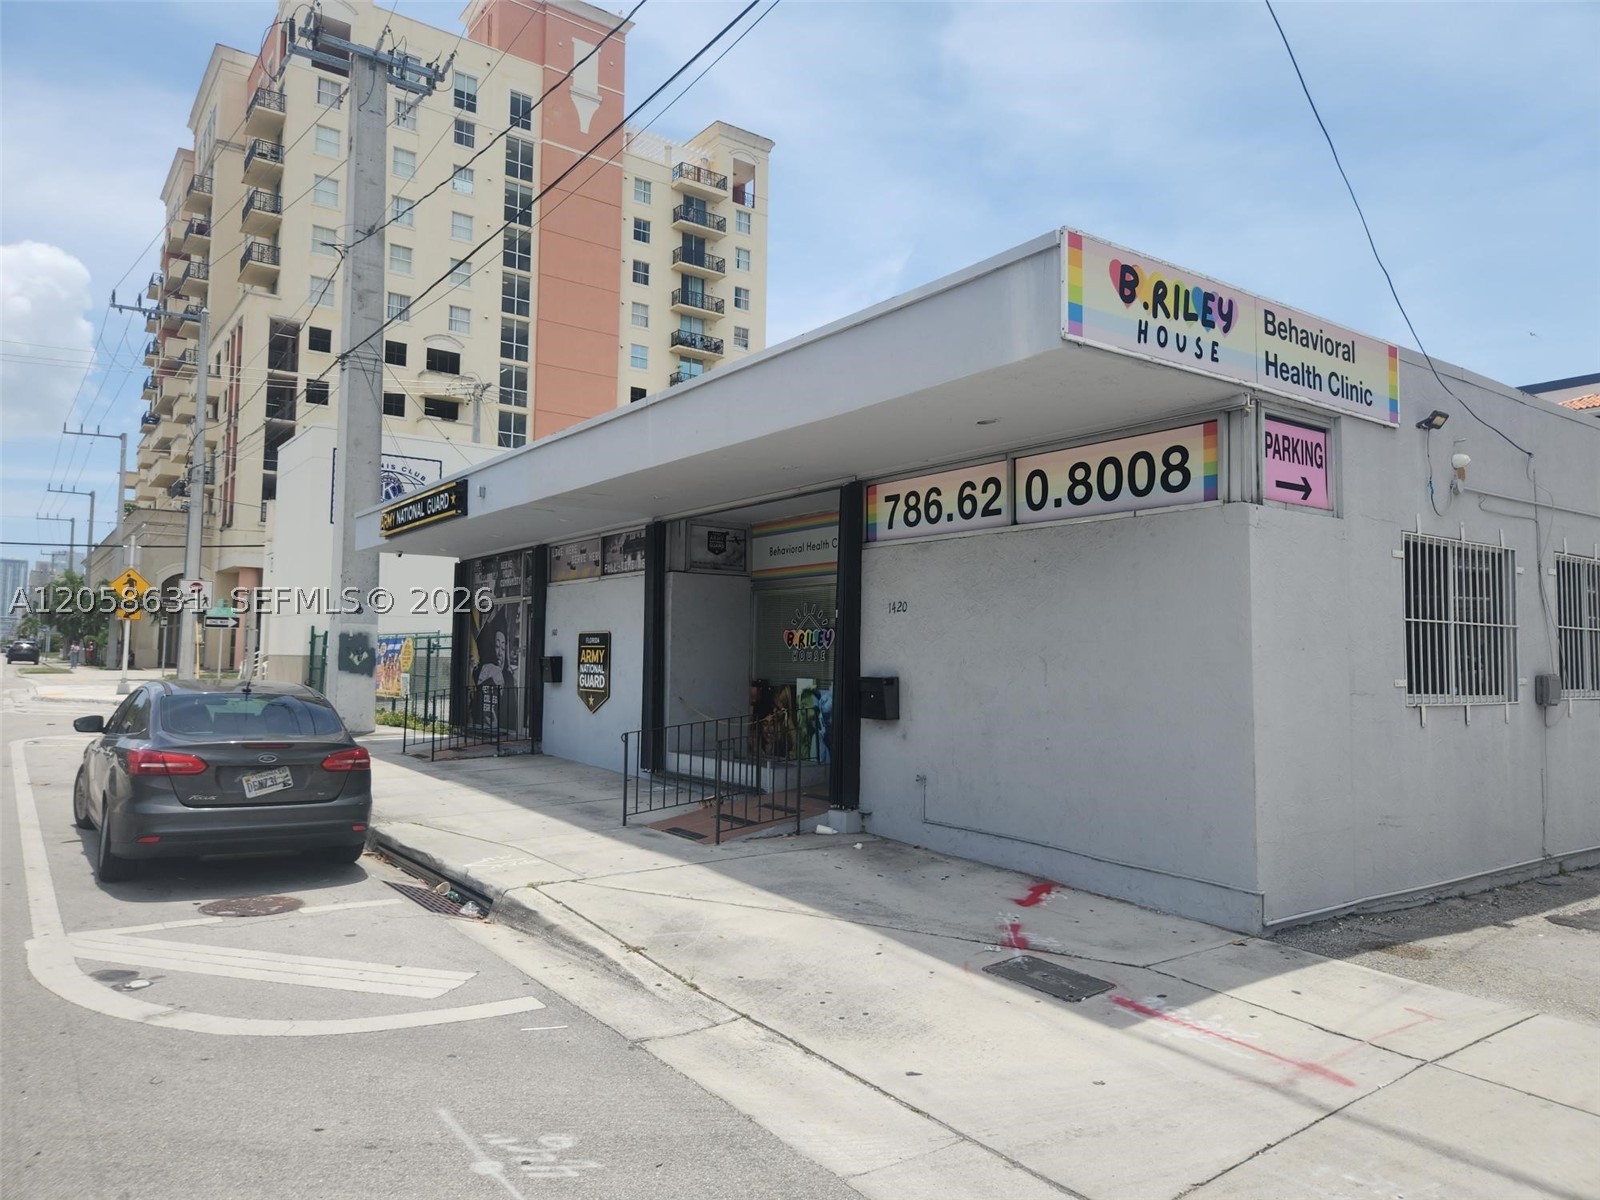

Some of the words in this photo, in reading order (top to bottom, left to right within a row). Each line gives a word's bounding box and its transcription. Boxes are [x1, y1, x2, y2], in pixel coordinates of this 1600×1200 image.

[1118, 263, 1234, 335] B.RILEY
[1137, 319, 1220, 363] HOUSE
[1264, 309, 1356, 364] Behavioral
[1265, 350, 1323, 393] Health
[1327, 370, 1374, 407] Clinic
[1264, 431, 1324, 470] PARKING
[401, 466, 427, 482] CLUB
[884, 476, 1002, 530] 786.62
[1025, 444, 1192, 512] 0.8008
[380, 512, 396, 529] ARMY
[396, 501, 425, 525] NATIONAL
[426, 492, 450, 515] GUARD
[769, 543, 805, 557] Behavioral
[806, 540, 830, 552] Health
[888, 601, 908, 614] 1420
[786, 630, 833, 649] B.RILEY
[580, 649, 605, 663] ARMY
[792, 650, 826, 662] HOUSE
[580, 663, 605, 674] NATIONAL
[580, 674, 605, 688] GUARD
